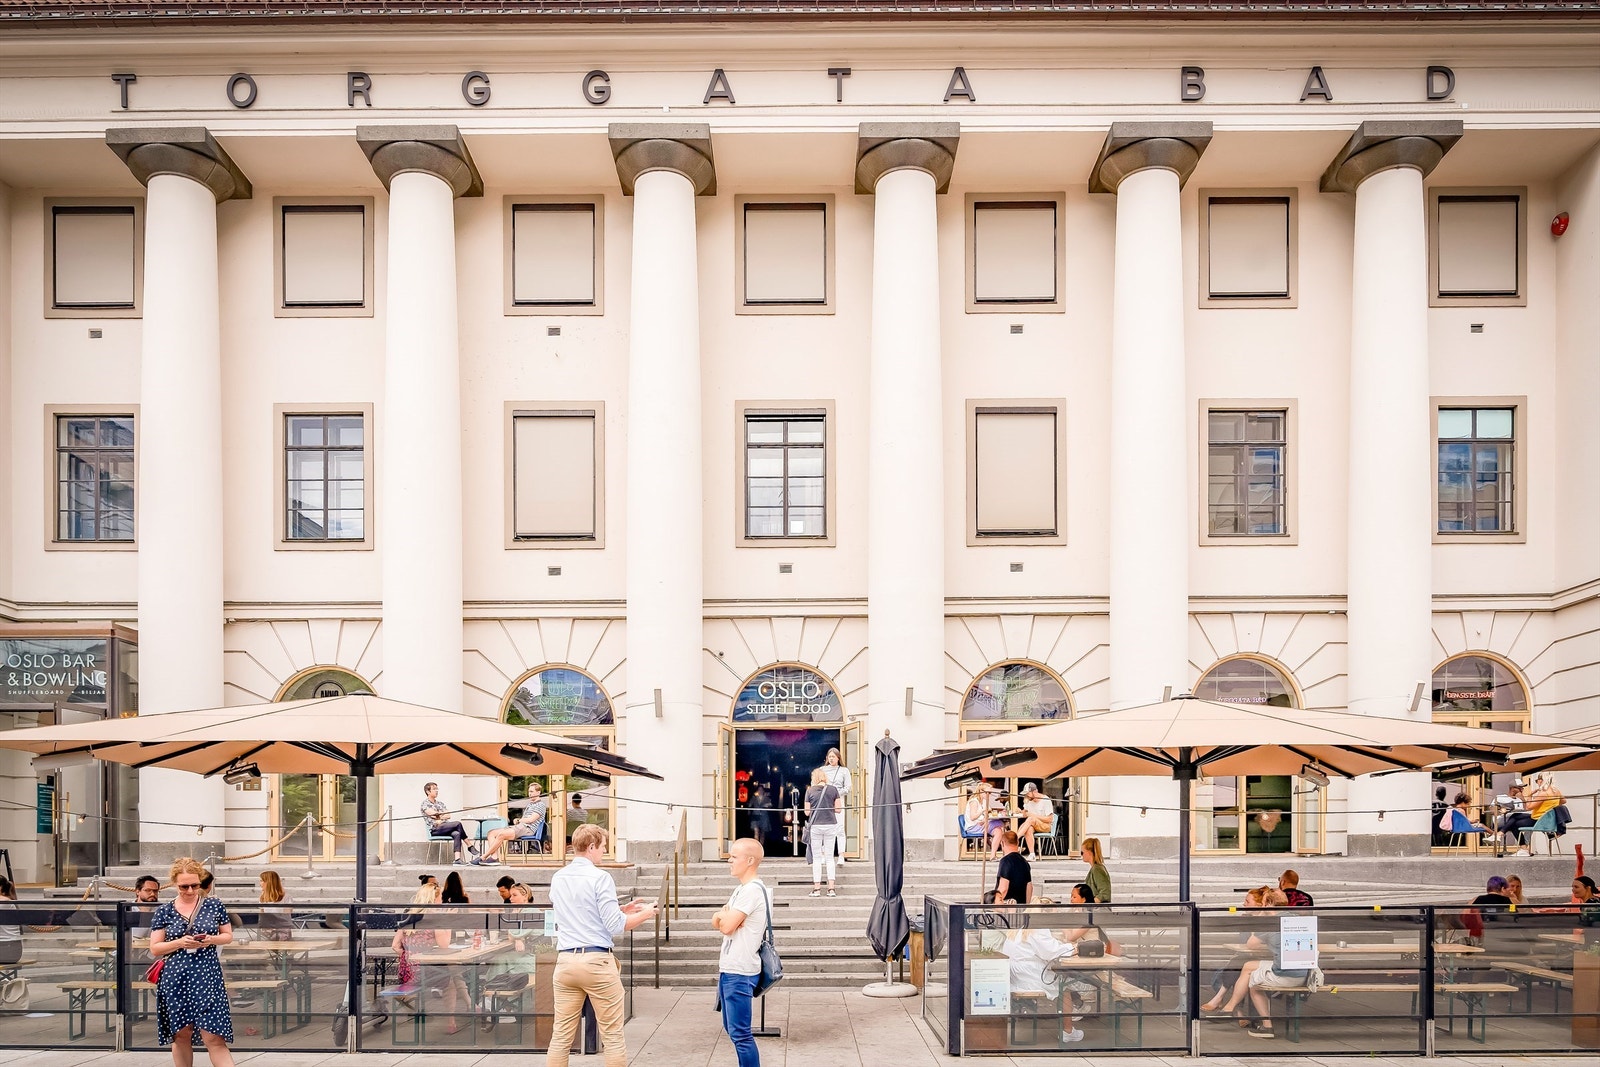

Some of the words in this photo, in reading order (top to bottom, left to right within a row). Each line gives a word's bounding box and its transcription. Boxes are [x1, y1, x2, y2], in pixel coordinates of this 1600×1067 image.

[111, 66, 976, 109] TORGGATA
[1181, 65, 1456, 102] BAD
[7, 653, 55, 669] OSLO
[62, 653, 96, 669] BAR
[7, 671, 20, 687] &
[23, 669, 107, 687] BOWLING
[757, 681, 821, 699] OSLO
[746, 703, 788, 714] STREET
[793, 703, 831, 714] FOOD
